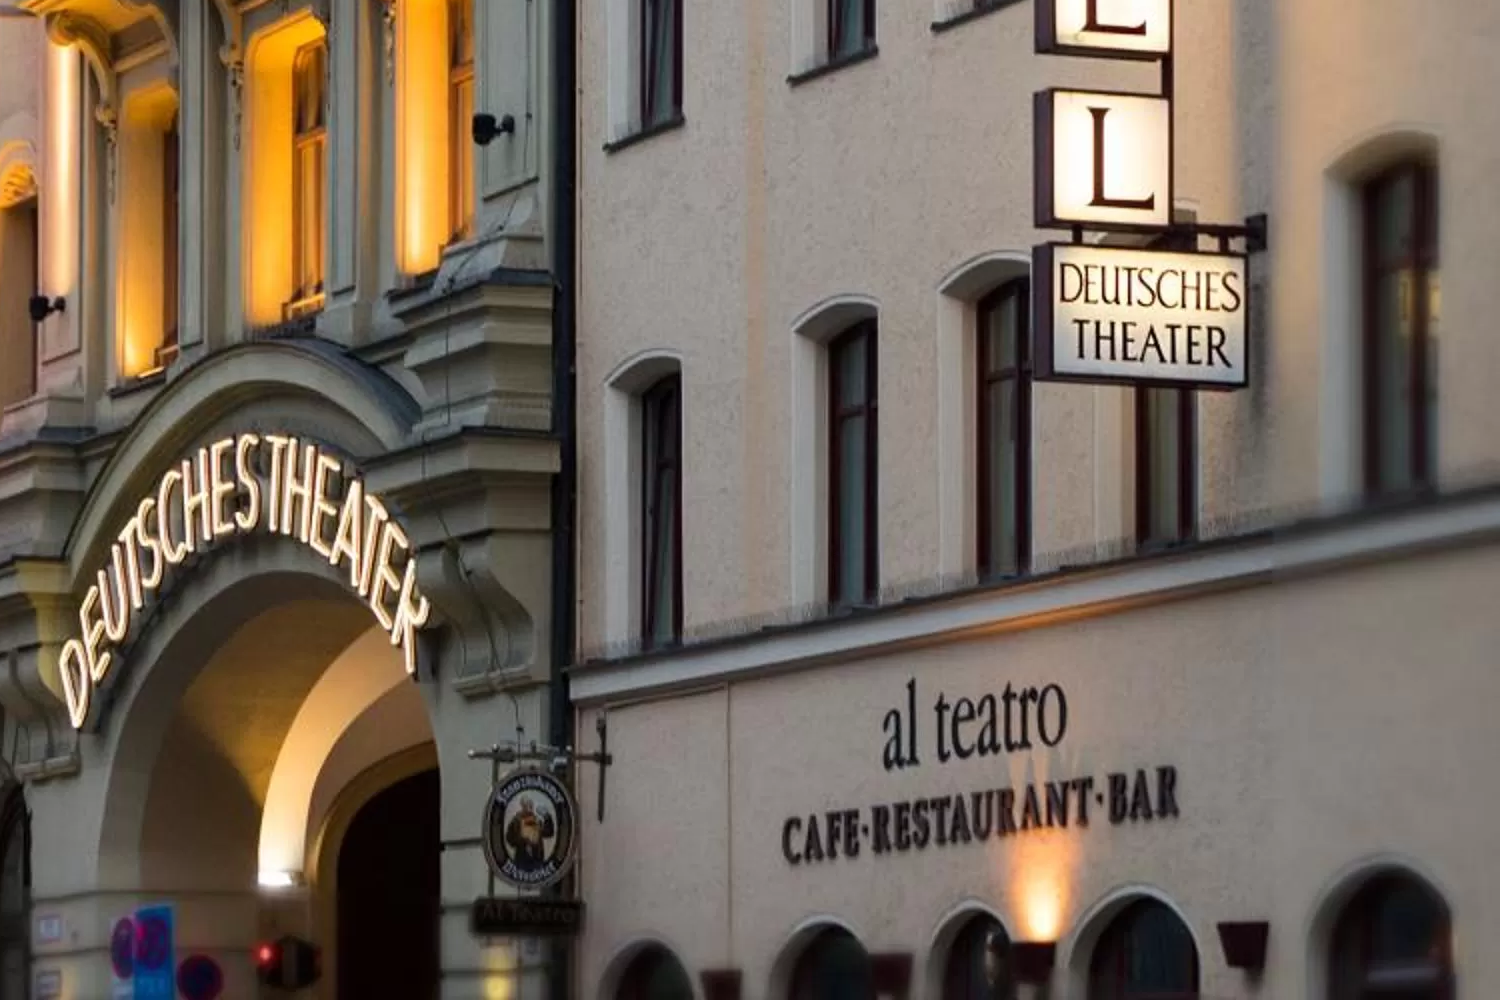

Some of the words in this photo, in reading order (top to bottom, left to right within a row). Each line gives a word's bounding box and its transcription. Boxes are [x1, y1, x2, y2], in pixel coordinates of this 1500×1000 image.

[1059, 263, 1241, 314] DEUTSCHES
[1072, 318, 1232, 369] THEATER
[882, 677, 919, 772] al
[934, 681, 1067, 763] teatro
